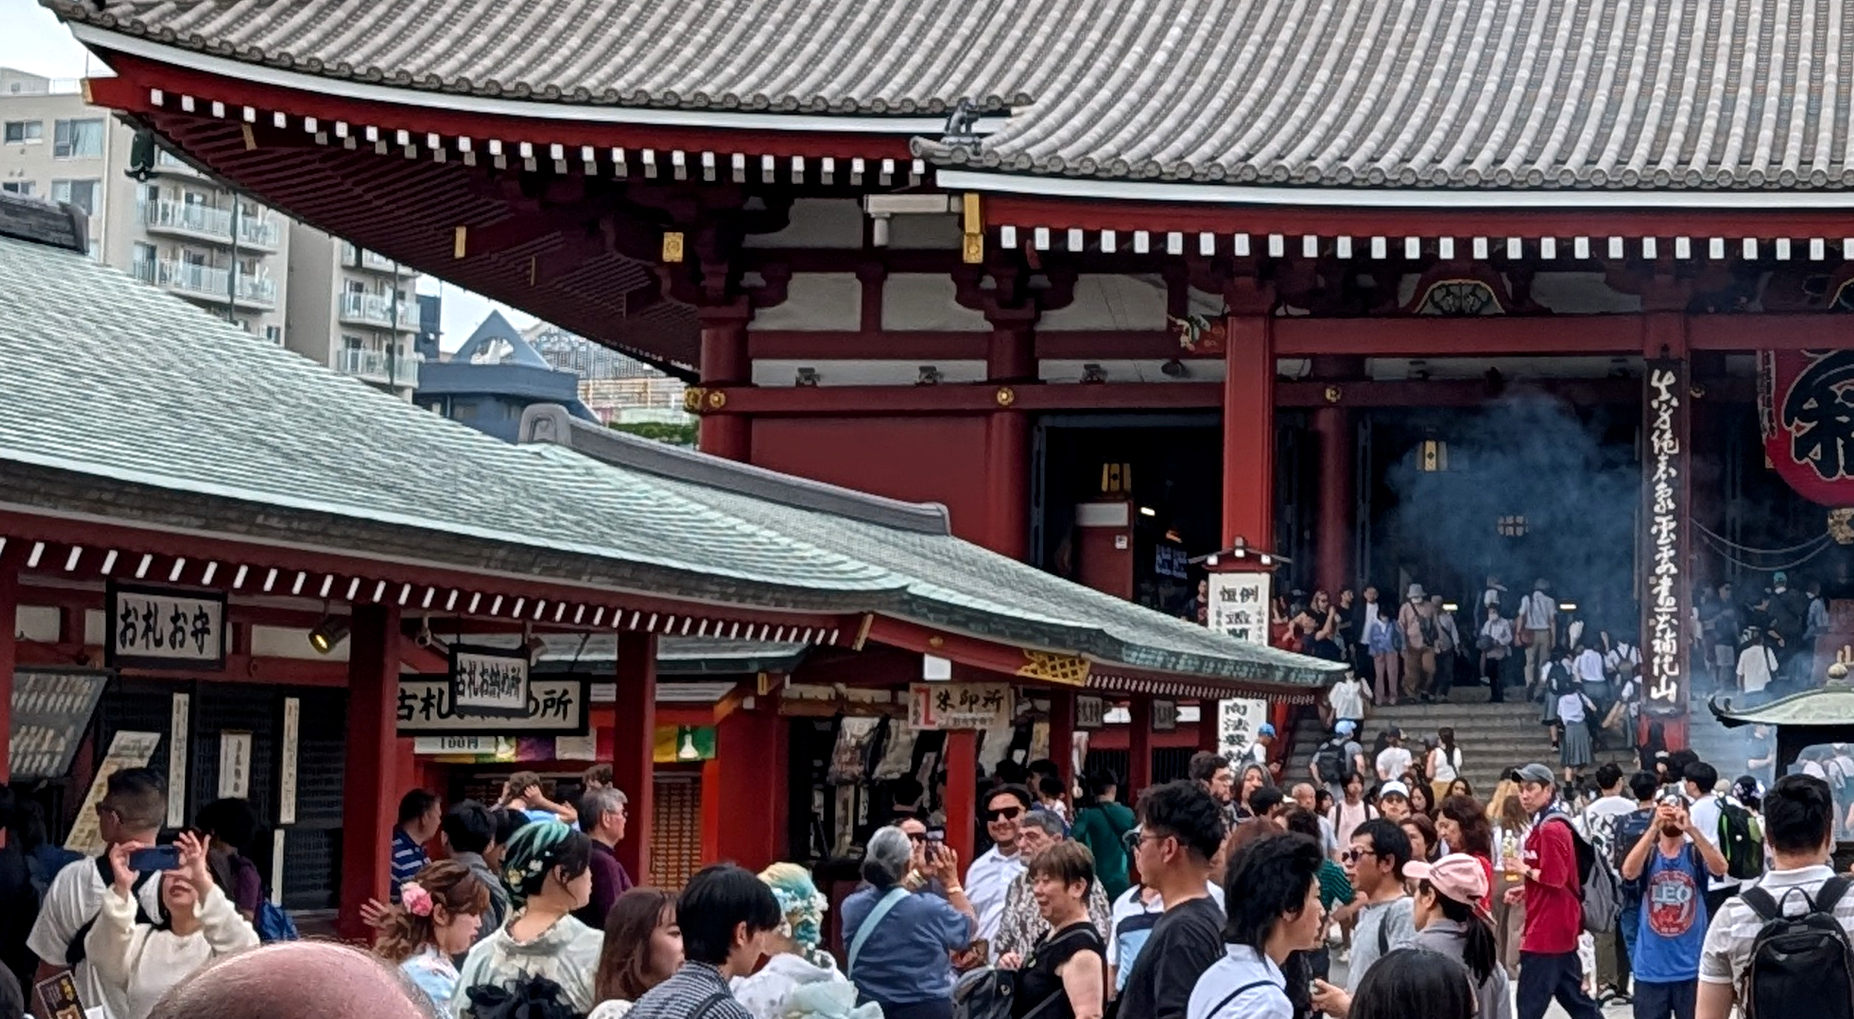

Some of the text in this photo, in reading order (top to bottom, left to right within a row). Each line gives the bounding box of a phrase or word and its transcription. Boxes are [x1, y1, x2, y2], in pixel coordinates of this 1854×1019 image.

[119, 598, 211, 655] お札お守
[1652, 884, 1693, 903] LEO
